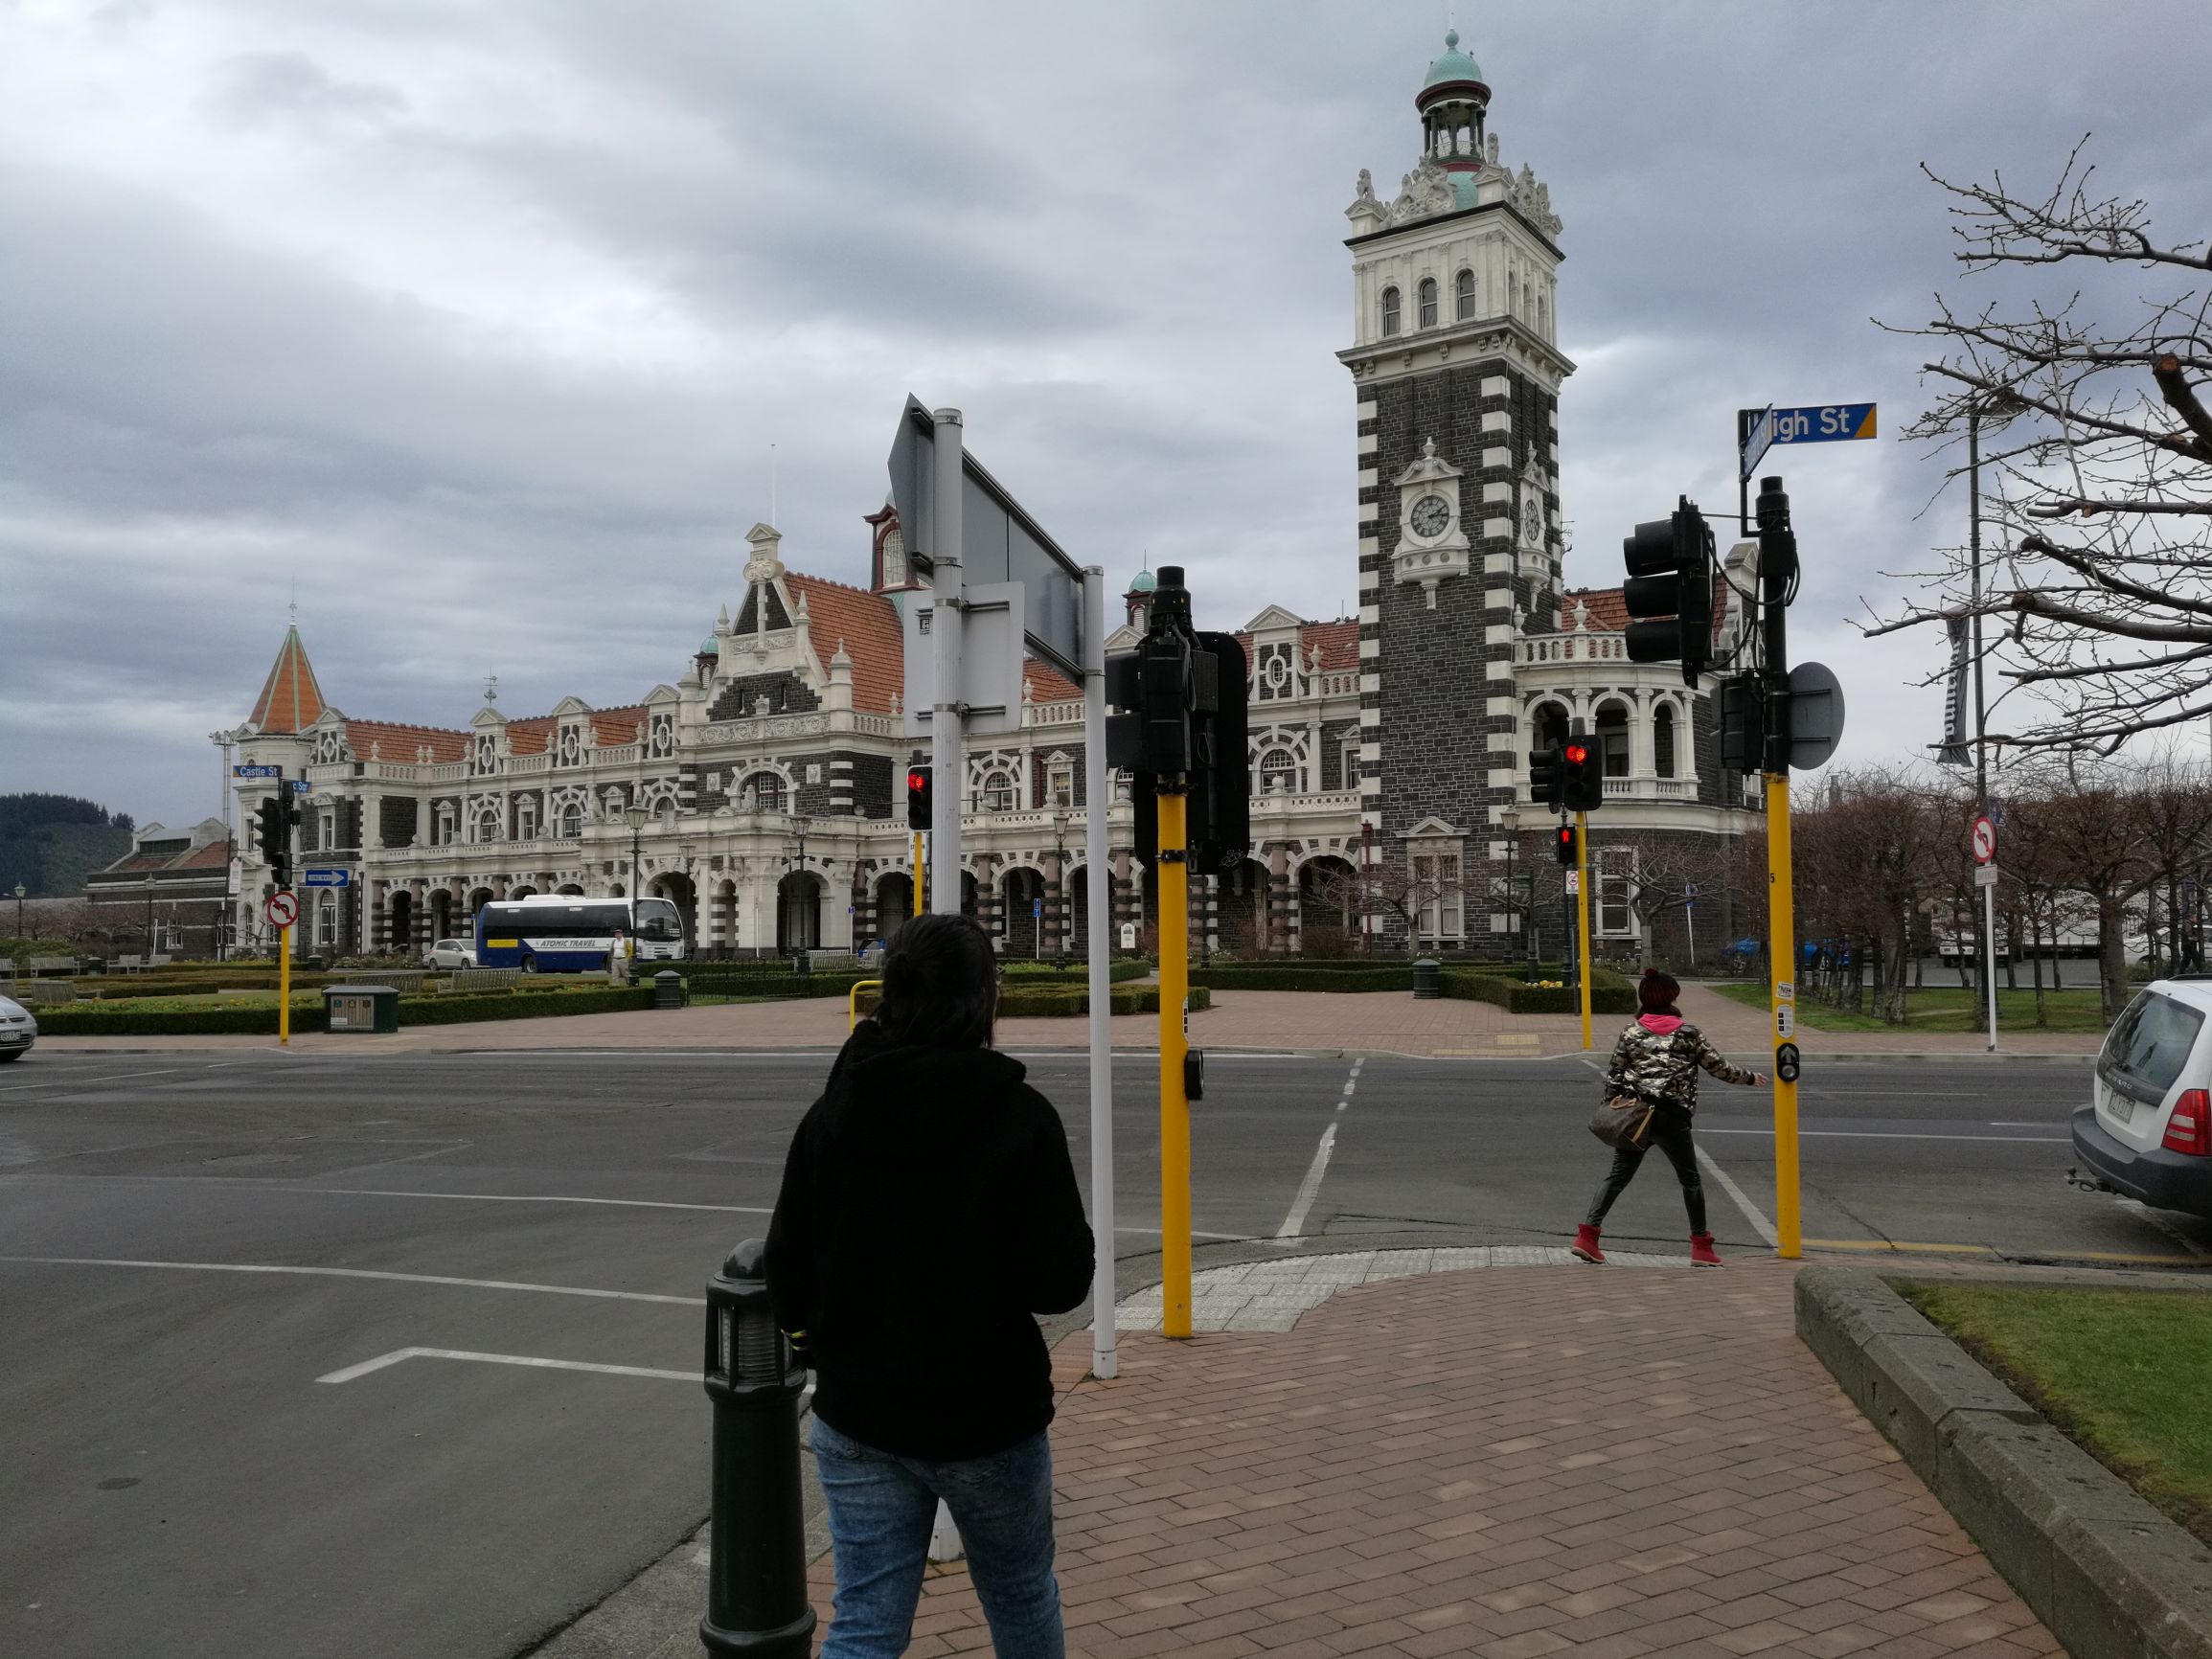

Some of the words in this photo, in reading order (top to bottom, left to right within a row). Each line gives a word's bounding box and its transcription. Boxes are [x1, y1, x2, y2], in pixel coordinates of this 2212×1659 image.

[1819, 407, 1850, 434] St
[239, 766, 265, 777] Castle
[268, 766, 278, 777] St
